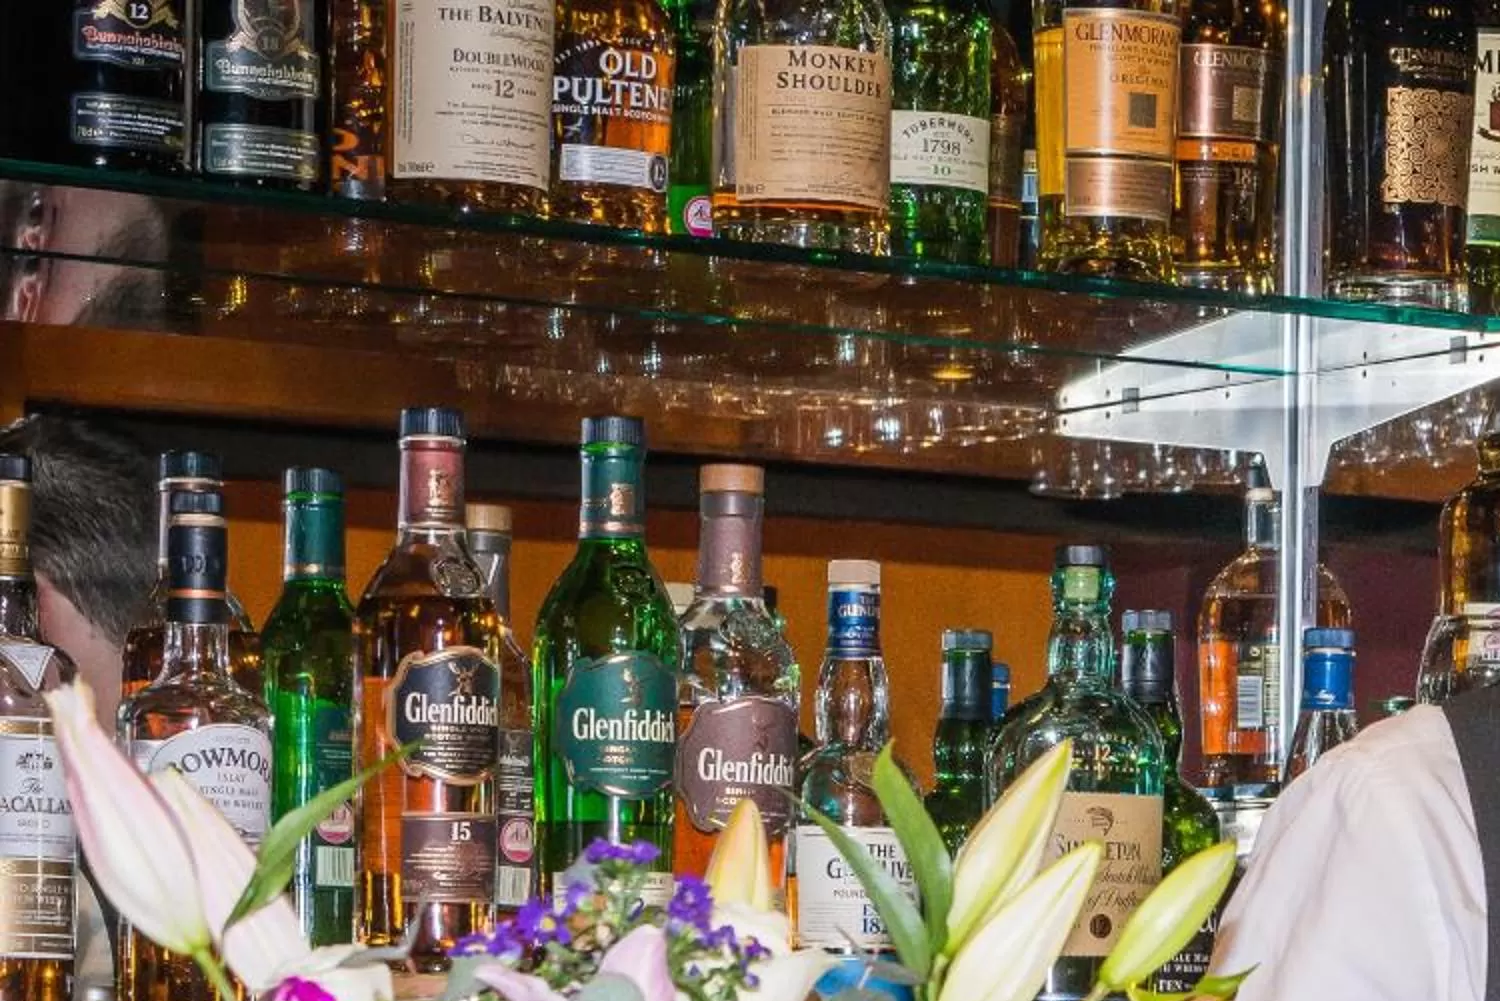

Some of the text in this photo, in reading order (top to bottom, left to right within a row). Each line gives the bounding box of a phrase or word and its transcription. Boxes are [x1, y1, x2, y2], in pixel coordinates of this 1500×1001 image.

[130, 3, 149, 19] 12
[438, 7, 472, 21] THE
[600, 48, 657, 79] OLD
[788, 50, 877, 77] MONKEY
[495, 79, 514, 99] 12
[776, 71, 882, 99] SHOULDER
[922, 137, 961, 157] 1798
[931, 164, 952, 176] 10
[217, 771, 246, 784] ISLAY
[451, 821, 472, 842] 15
[866, 843, 896, 859] THE
